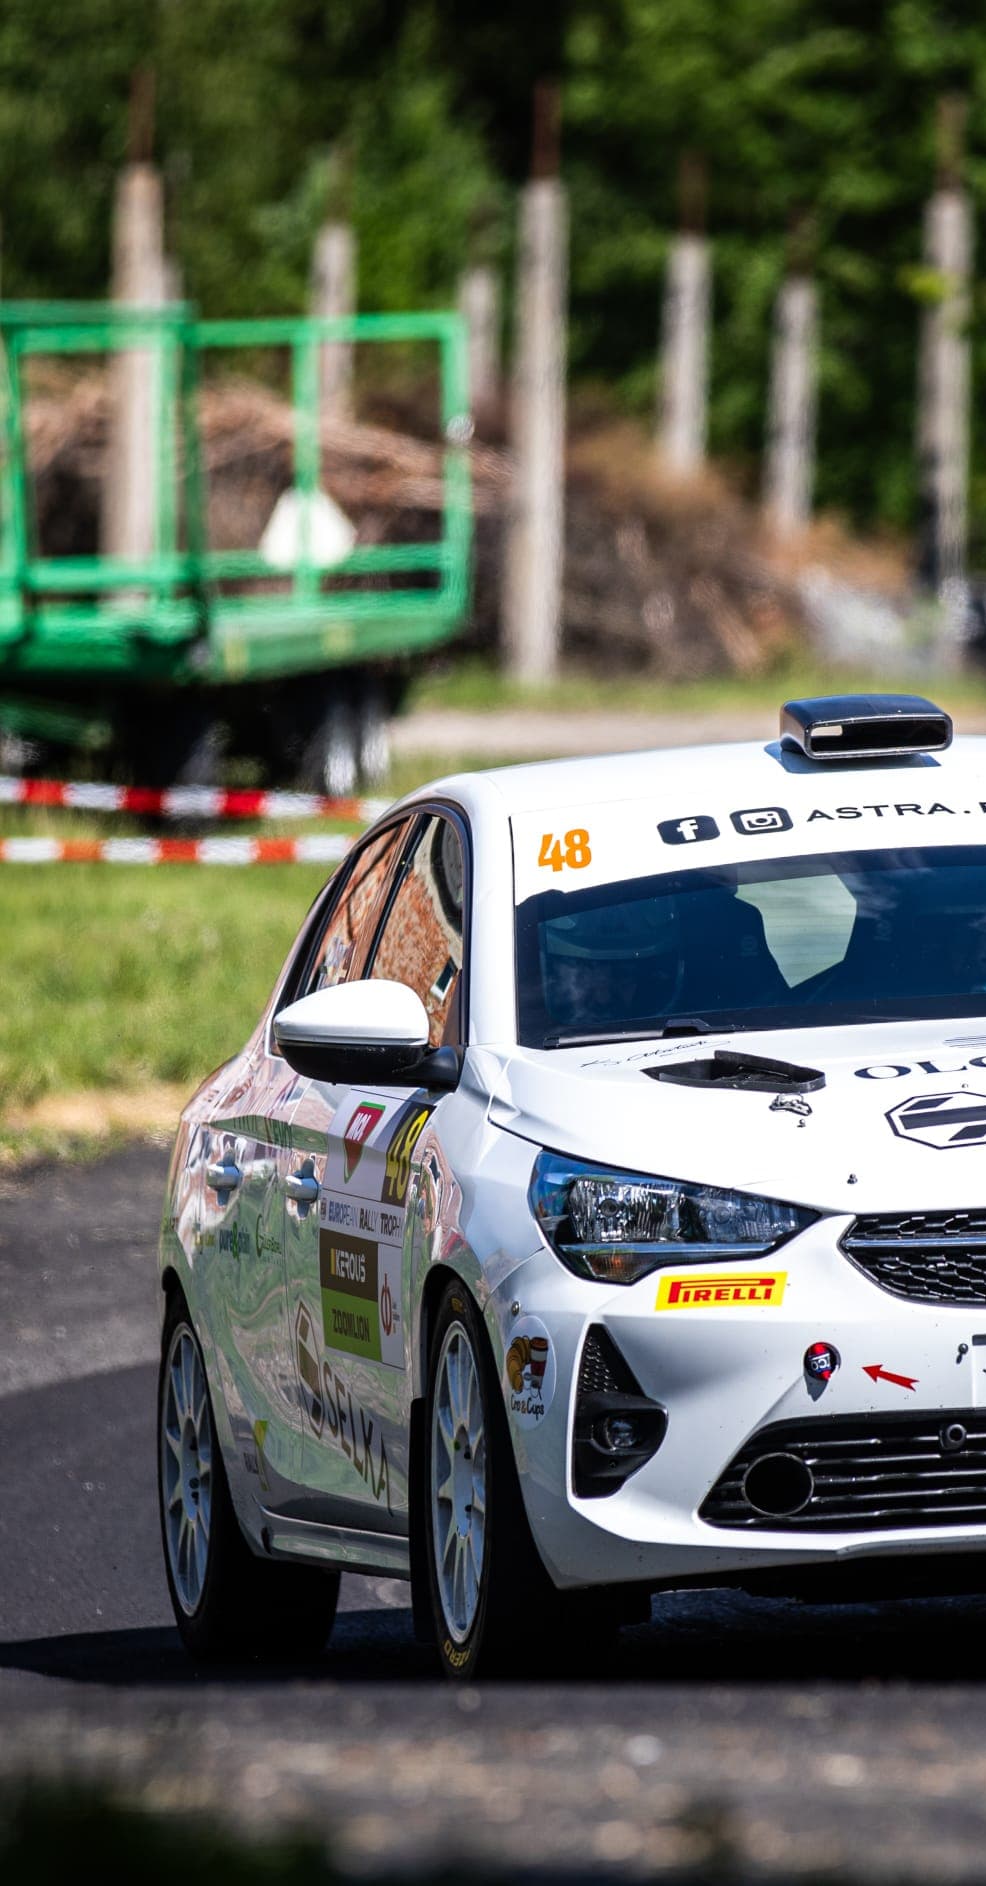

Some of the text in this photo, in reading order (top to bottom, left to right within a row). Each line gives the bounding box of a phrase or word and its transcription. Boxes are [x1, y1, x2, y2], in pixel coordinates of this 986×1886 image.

[538, 829, 592, 872] 48
[386, 1107, 429, 1200] 48
[667, 1278, 776, 1304] PIRELLI
[332, 1307, 370, 1343] ZOOMLION
[323, 1361, 394, 1517] SELKA
